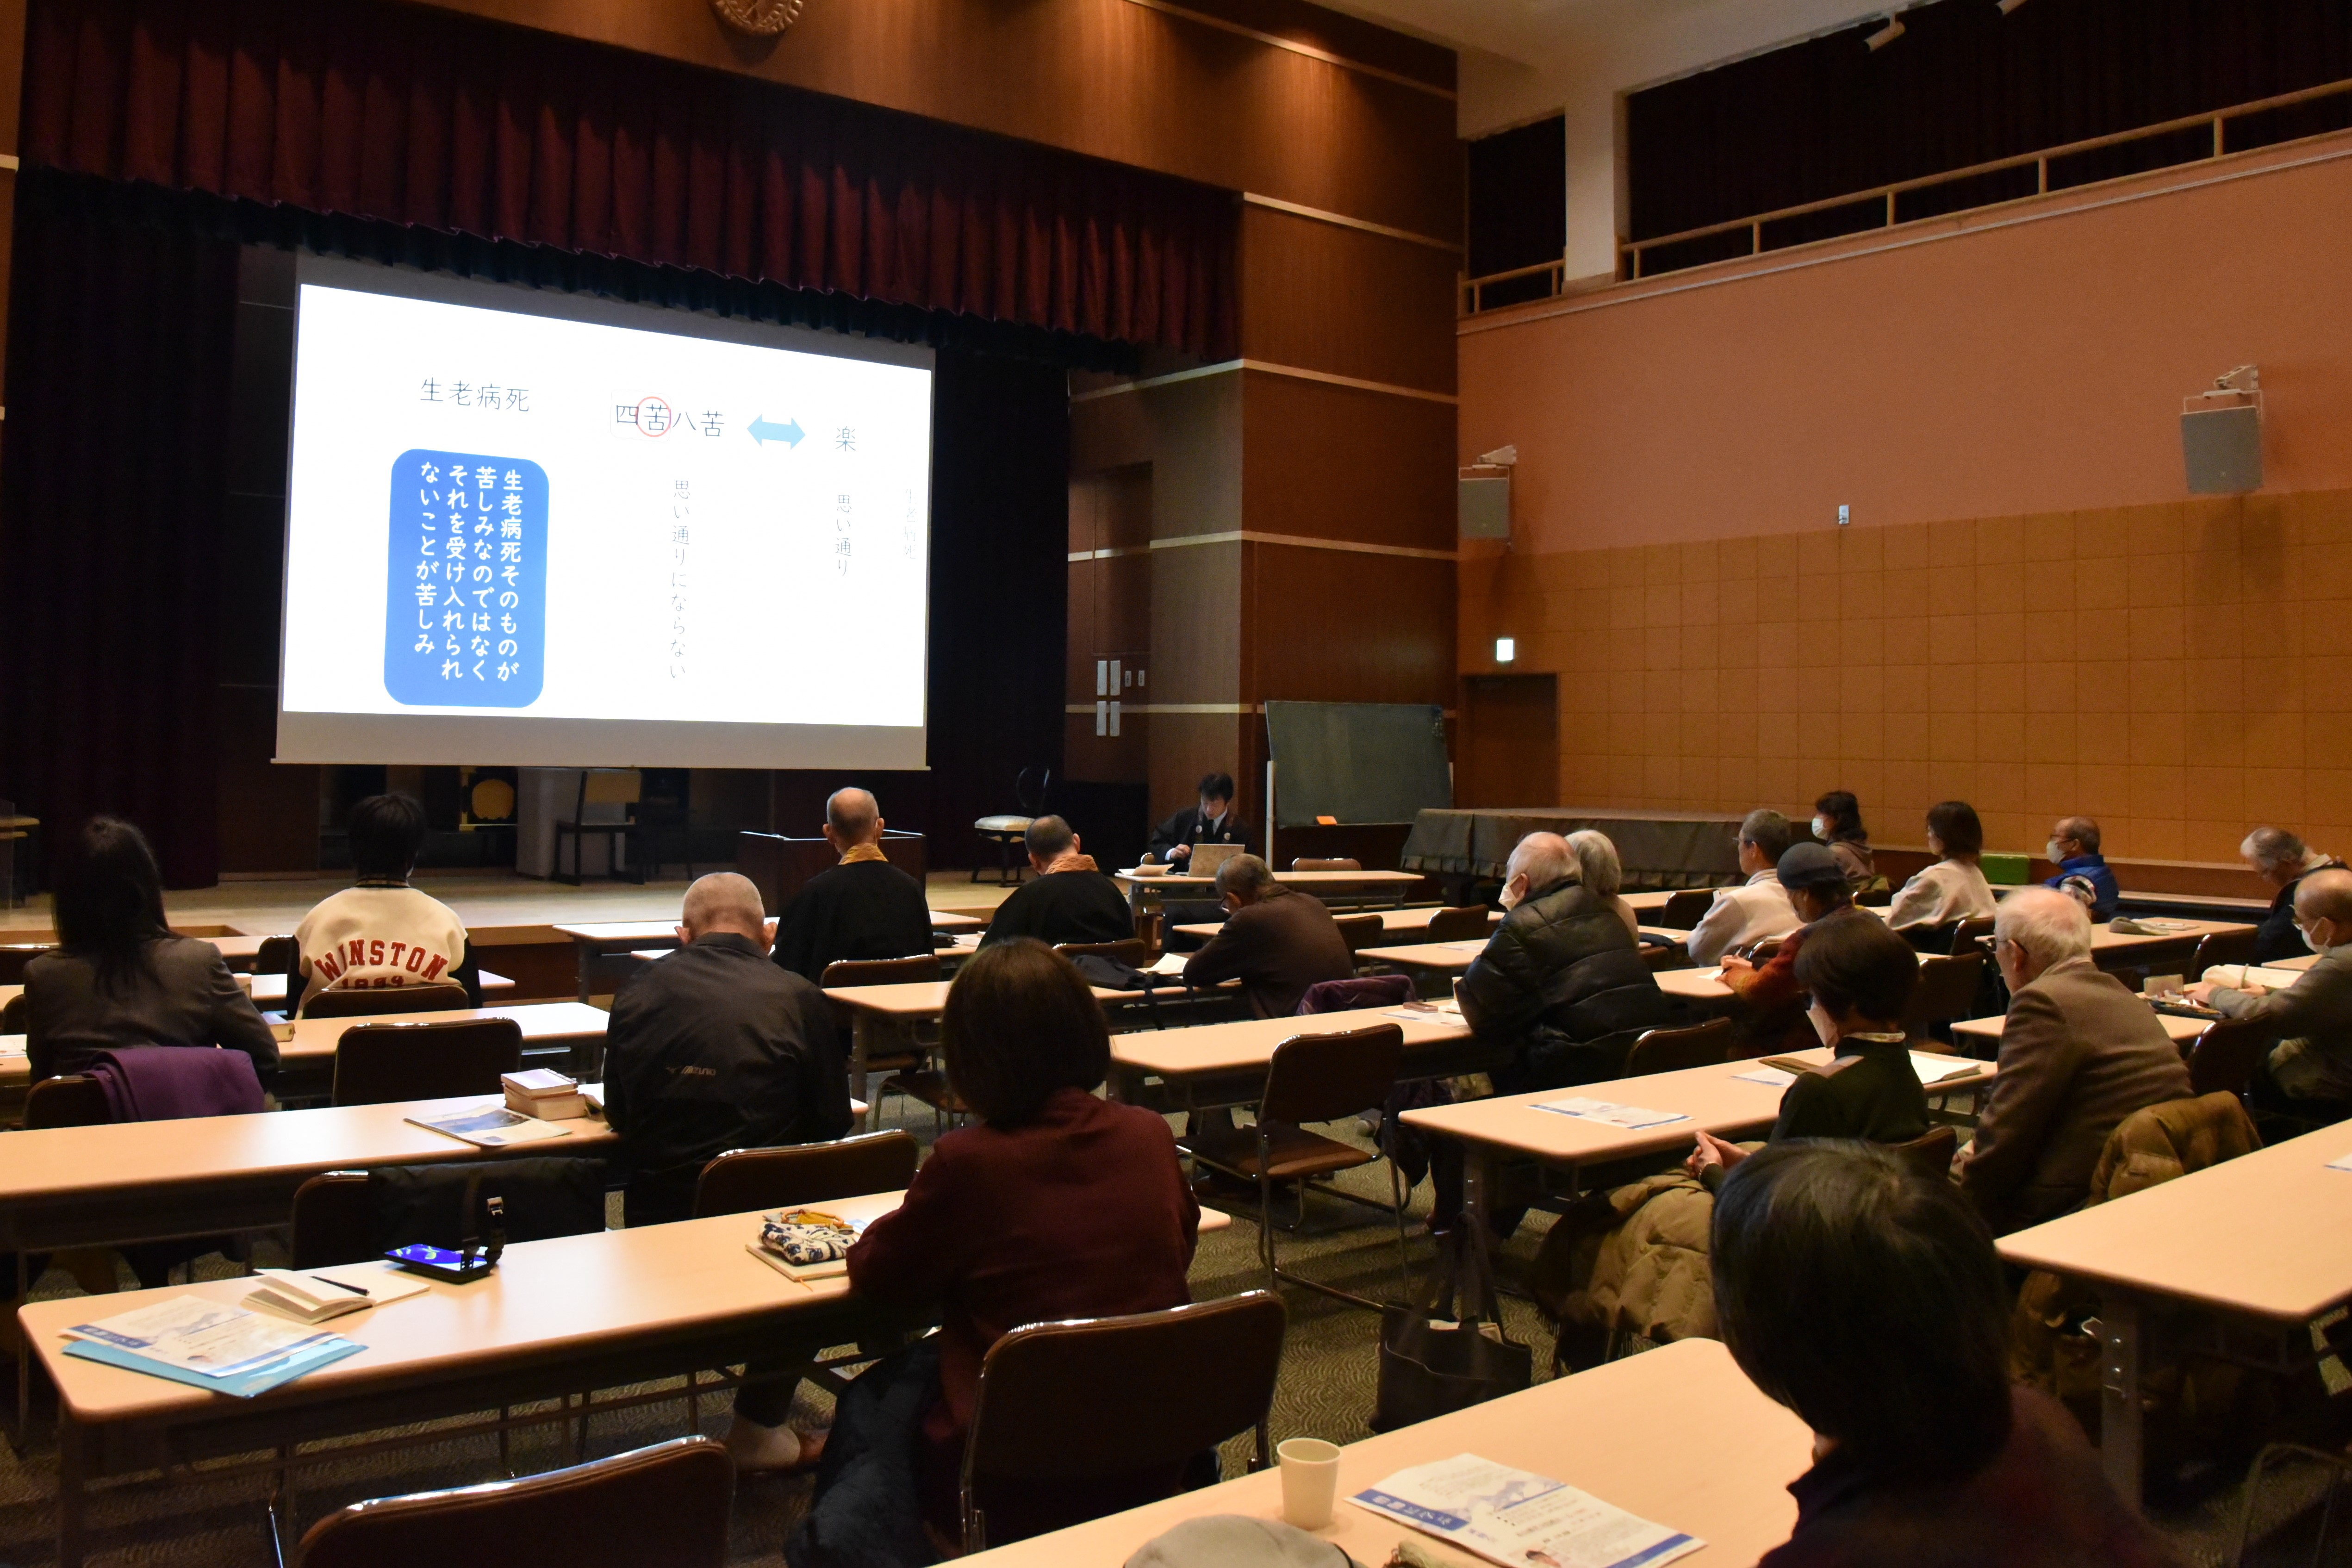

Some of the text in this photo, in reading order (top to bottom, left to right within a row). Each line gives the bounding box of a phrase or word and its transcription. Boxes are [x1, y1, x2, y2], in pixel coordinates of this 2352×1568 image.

[420, 377, 529, 412] 生老病死
[616, 404, 724, 437] 四苦八苦
[835, 425, 856, 452] 楽
[415, 461, 440, 654] ないことが苦しみ
[442, 465, 469, 680] それを受け入れられ
[471, 466, 497, 681] 苦しみなのではなく
[497, 469, 523, 682] 生老病死そのものが
[670, 480, 691, 678] 思い通りにならない
[835, 495, 852, 576] 思い通り
[314, 939, 448, 982] WINSTON
